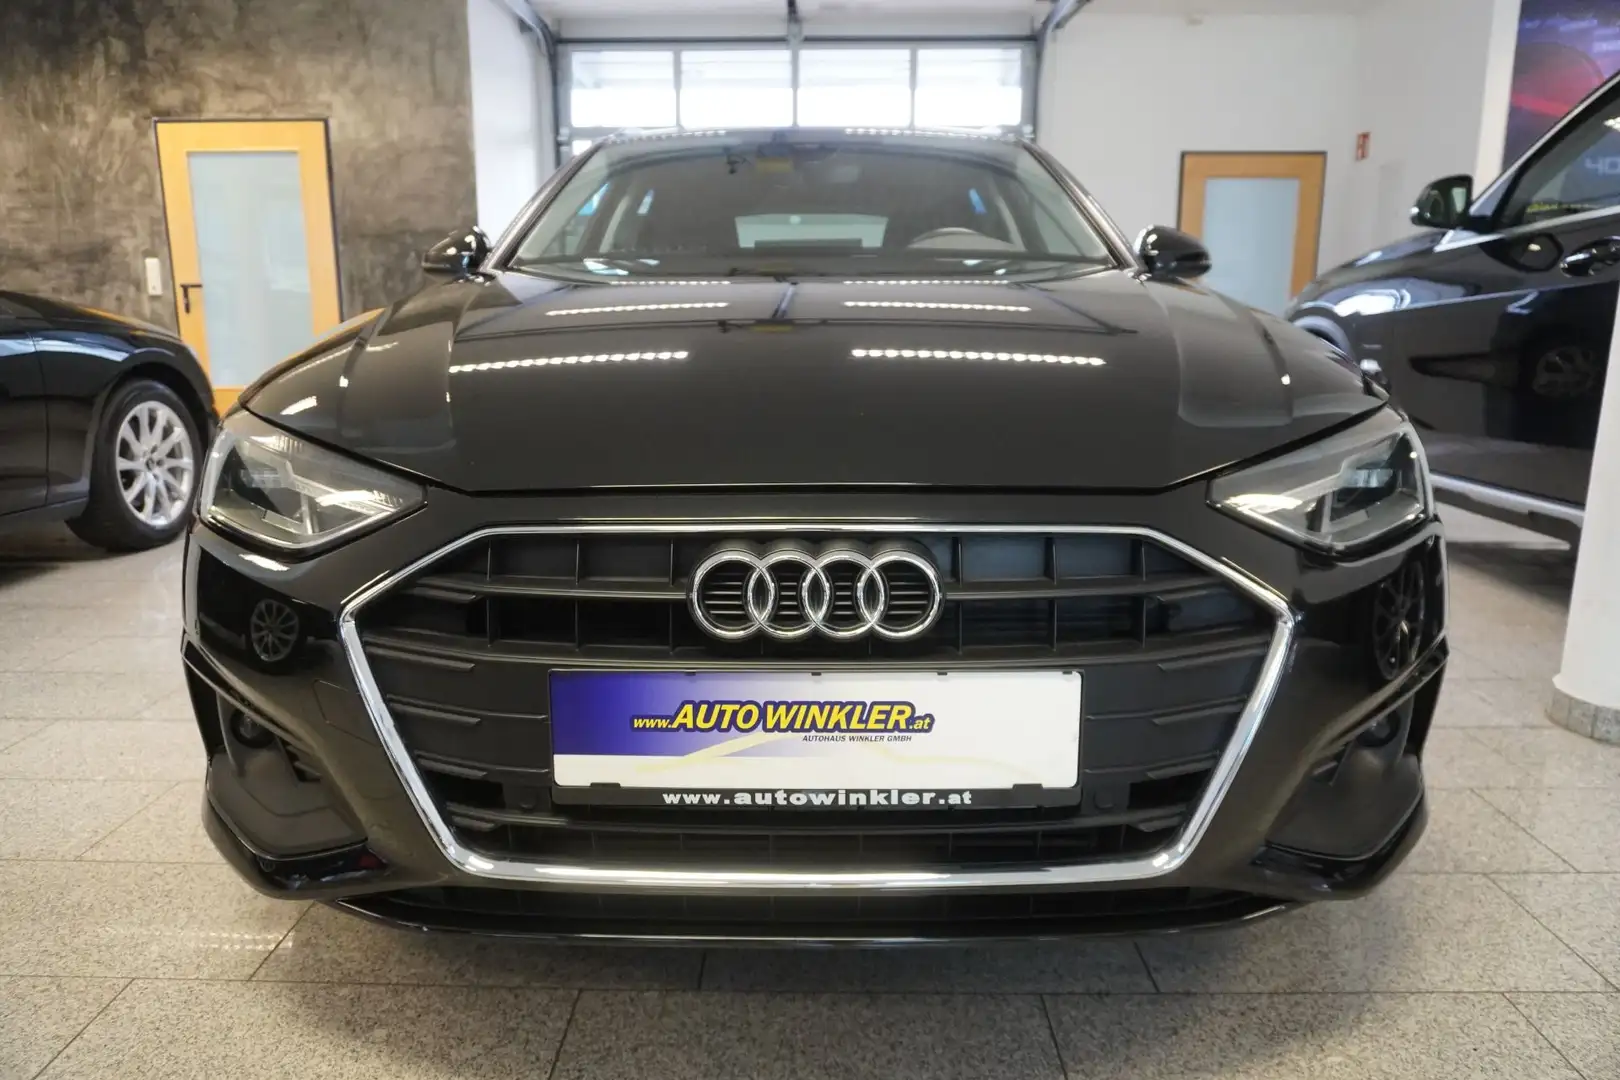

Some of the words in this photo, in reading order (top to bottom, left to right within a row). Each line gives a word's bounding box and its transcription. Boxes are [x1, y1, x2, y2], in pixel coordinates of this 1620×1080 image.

[802, 735, 846, 743] AUTOHAUS
[849, 735, 885, 743] WINKLER
[887, 735, 912, 743] GMBH
[662, 789, 972, 806] www.autowinkler.at
